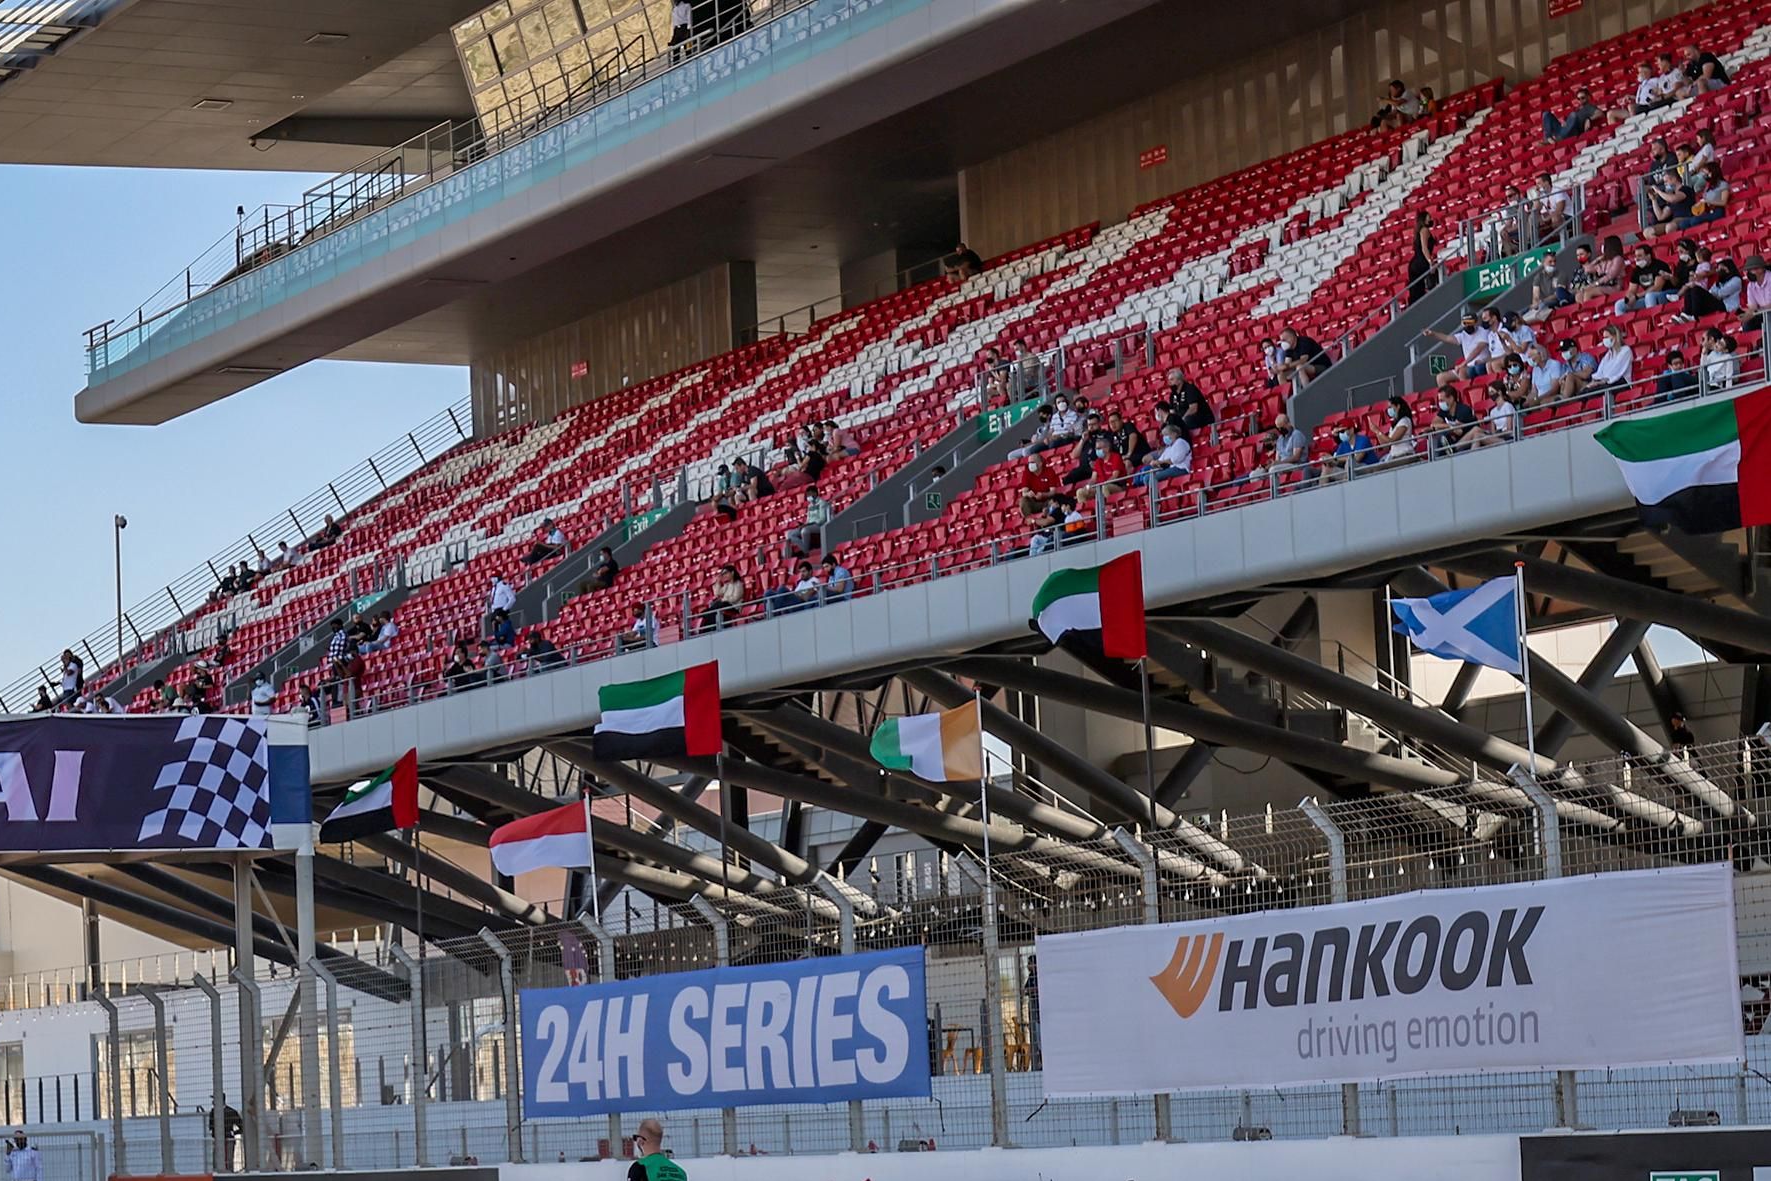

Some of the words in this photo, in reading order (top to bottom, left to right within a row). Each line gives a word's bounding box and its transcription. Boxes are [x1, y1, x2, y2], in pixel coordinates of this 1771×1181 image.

[1479, 263, 1512, 291] Exit
[535, 992, 652, 1103] 24H
[667, 964, 911, 1095] SERIES
[1297, 1009, 1399, 1063] driving
[1406, 1002, 1540, 1056] emotion
